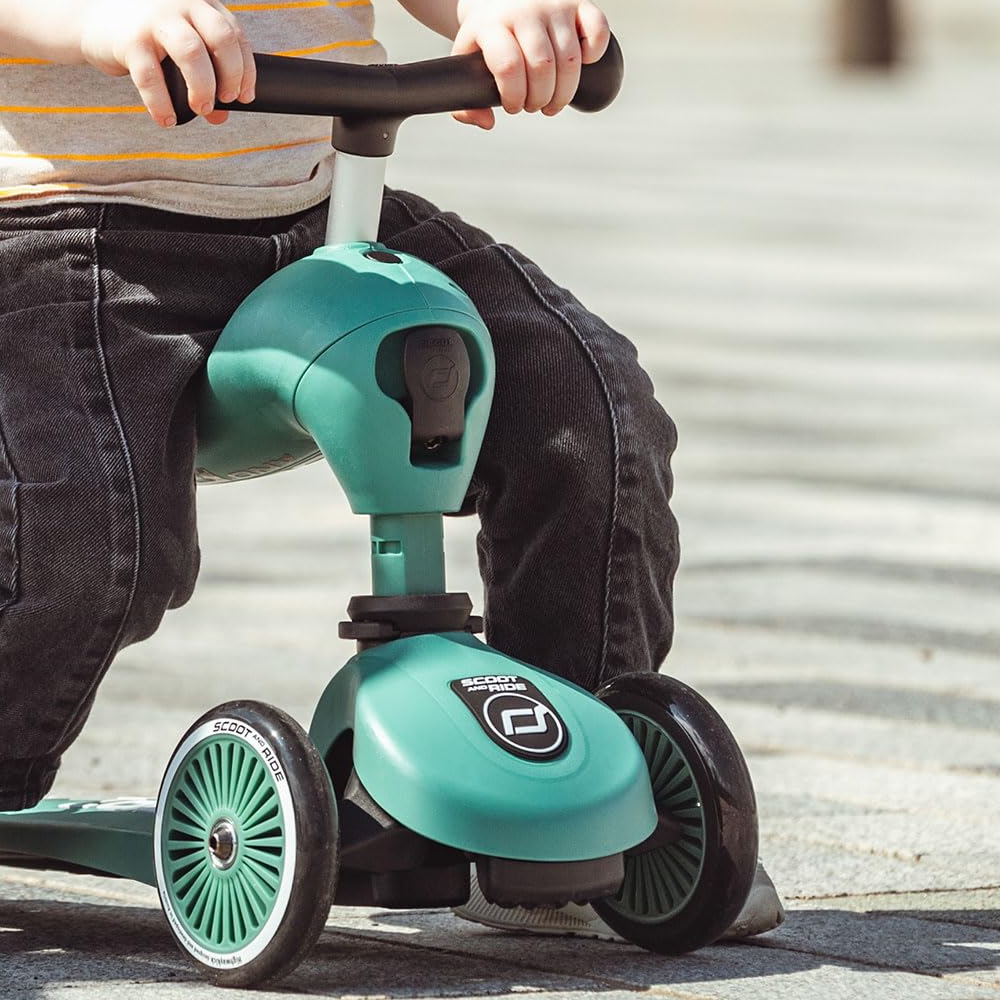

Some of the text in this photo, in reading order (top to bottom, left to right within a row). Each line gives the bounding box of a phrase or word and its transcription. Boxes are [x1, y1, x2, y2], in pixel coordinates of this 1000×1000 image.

[460, 675, 518, 687] SCOOT
[467, 683, 528, 693] AND RIDE
[213, 721, 285, 782] SCOOT AND RIDE
